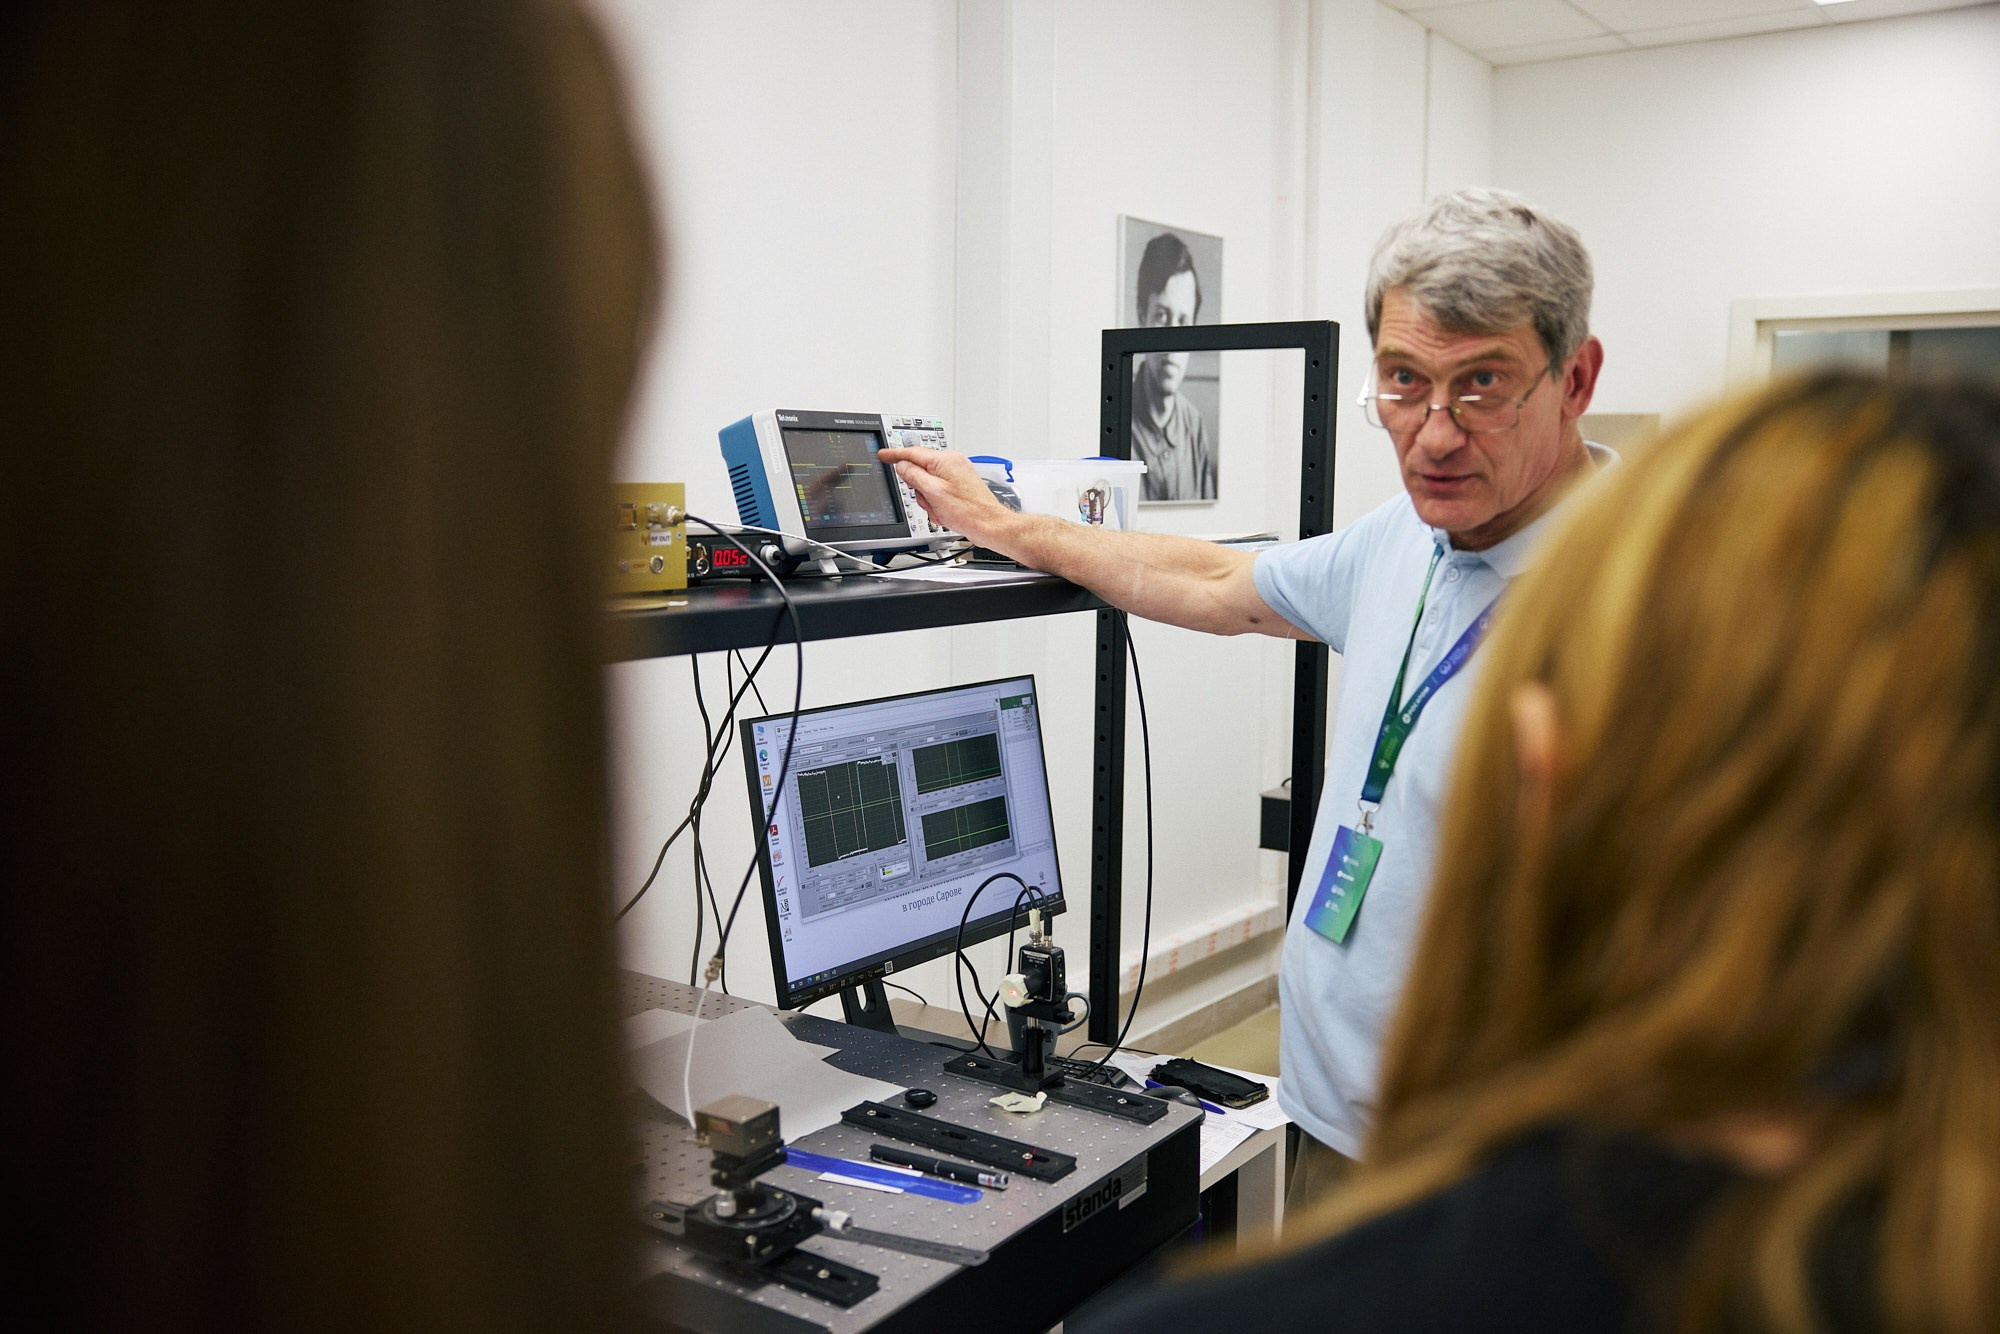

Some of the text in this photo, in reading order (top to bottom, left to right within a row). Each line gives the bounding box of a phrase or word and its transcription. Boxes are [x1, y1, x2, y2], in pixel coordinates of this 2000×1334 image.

[902, 904, 908, 912] в
[908, 895, 935, 910] городе
[936, 887, 962, 901] Сарове
[1066, 1178, 1122, 1227] standa
